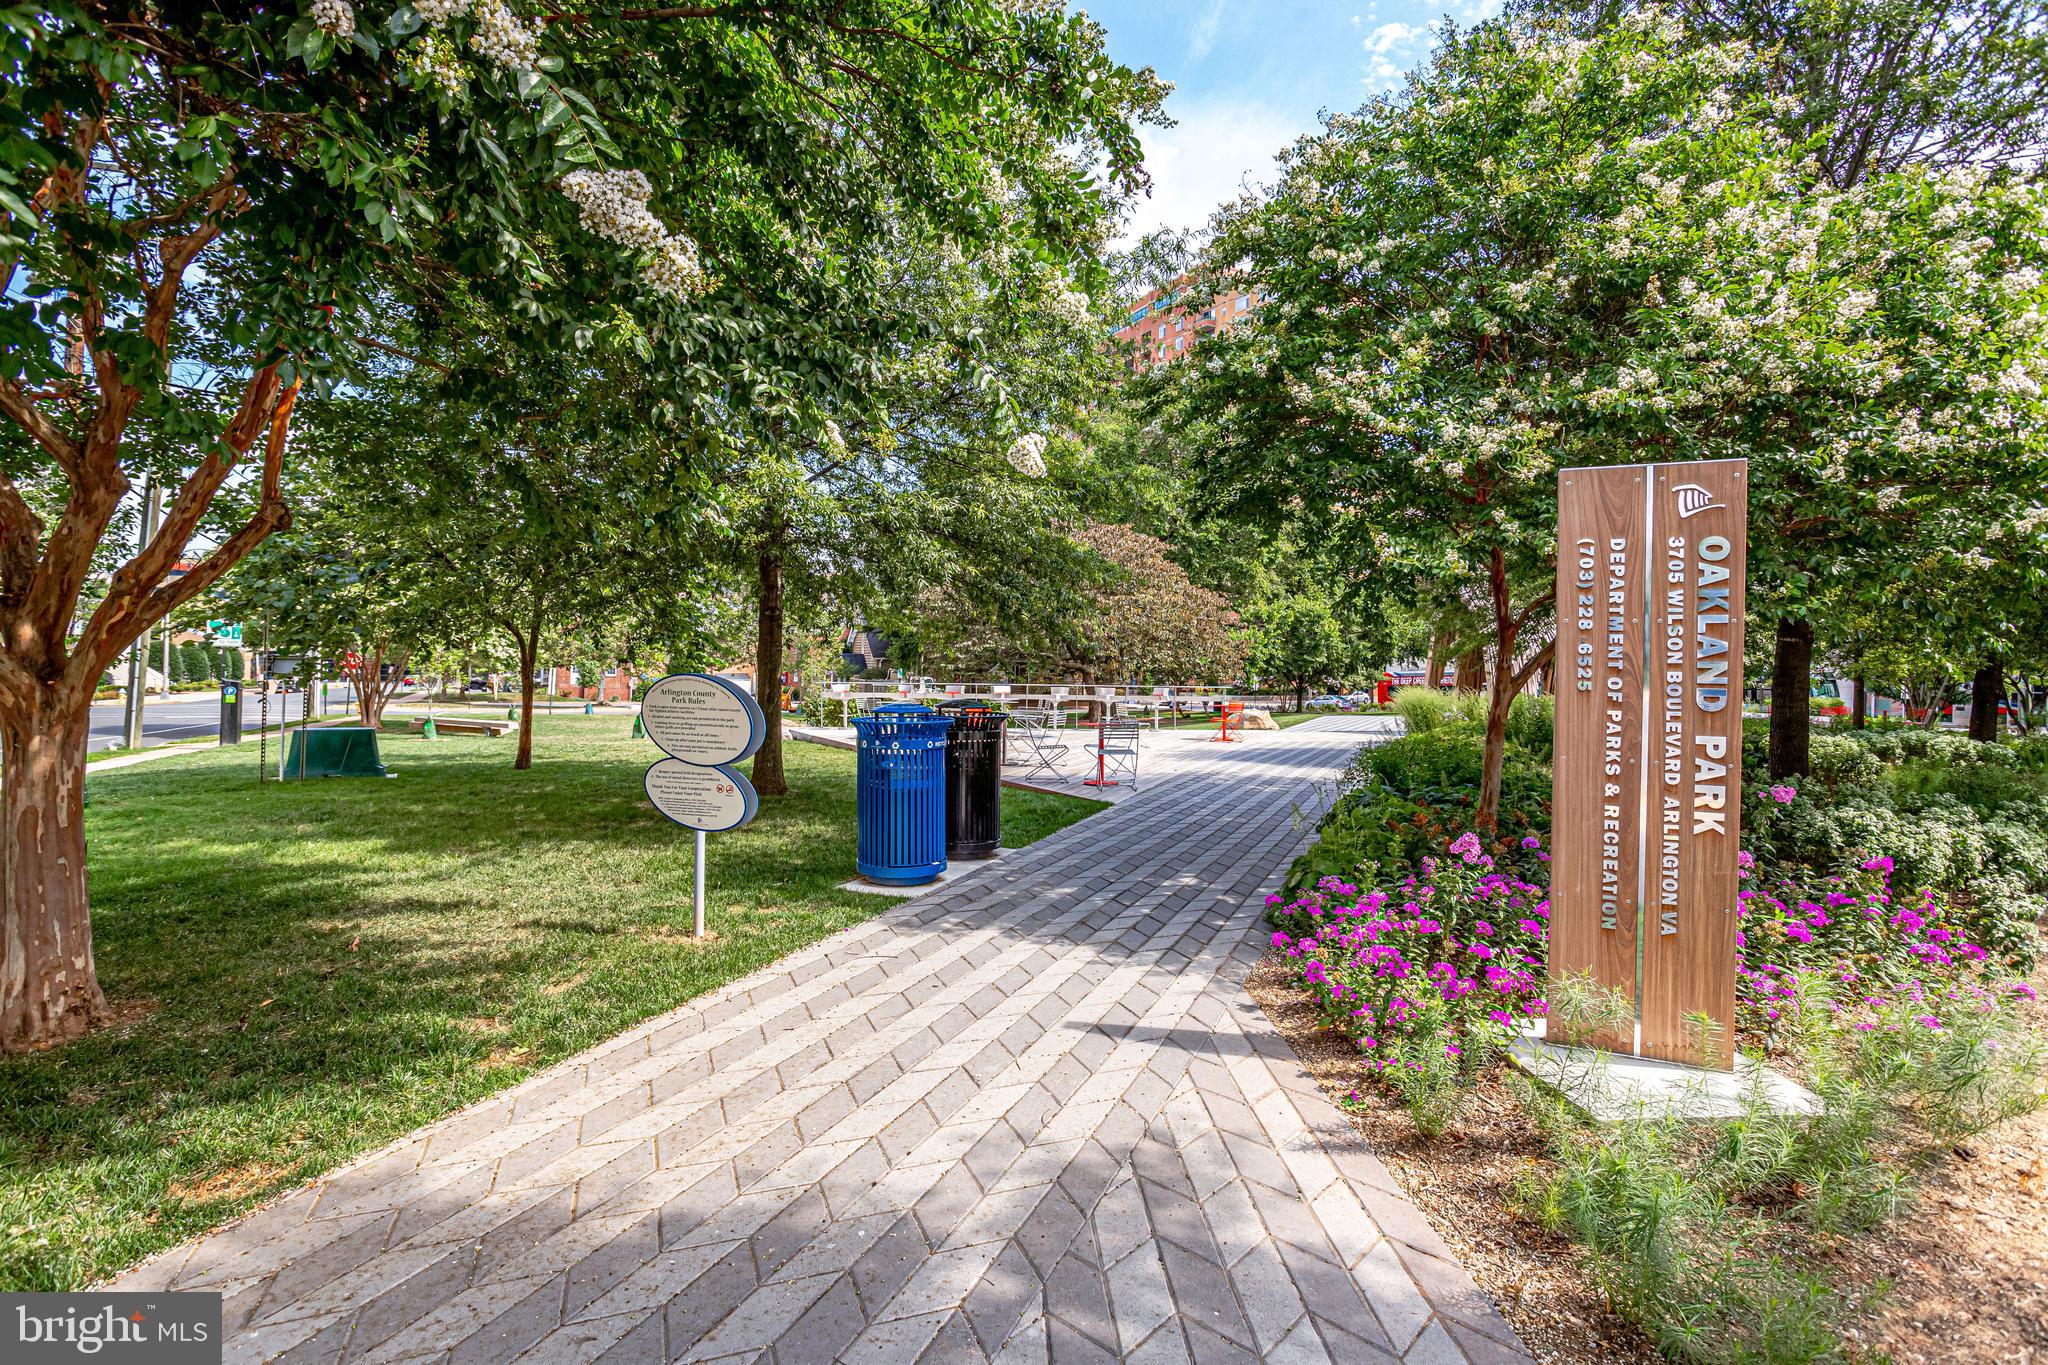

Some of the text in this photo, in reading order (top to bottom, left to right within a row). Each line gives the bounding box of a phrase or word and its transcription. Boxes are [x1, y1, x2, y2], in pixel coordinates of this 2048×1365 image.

[1576, 538, 1595, 589] (703)
[1577, 594, 1594, 631] 228
[660, 688, 692, 697] Arlington
[692, 690, 716, 699] County
[671, 696, 706, 705] Park Rules
[1400, 676, 1413, 685] DEEP
[1693, 535, 1731, 836] OAKLAND PARK
[1601, 538, 1626, 930] DEPARTMENT OF PARKS & RECREATION
[1660, 536, 1685, 935] 3705 WILSON BOULEVARD ARLINGTON VA
